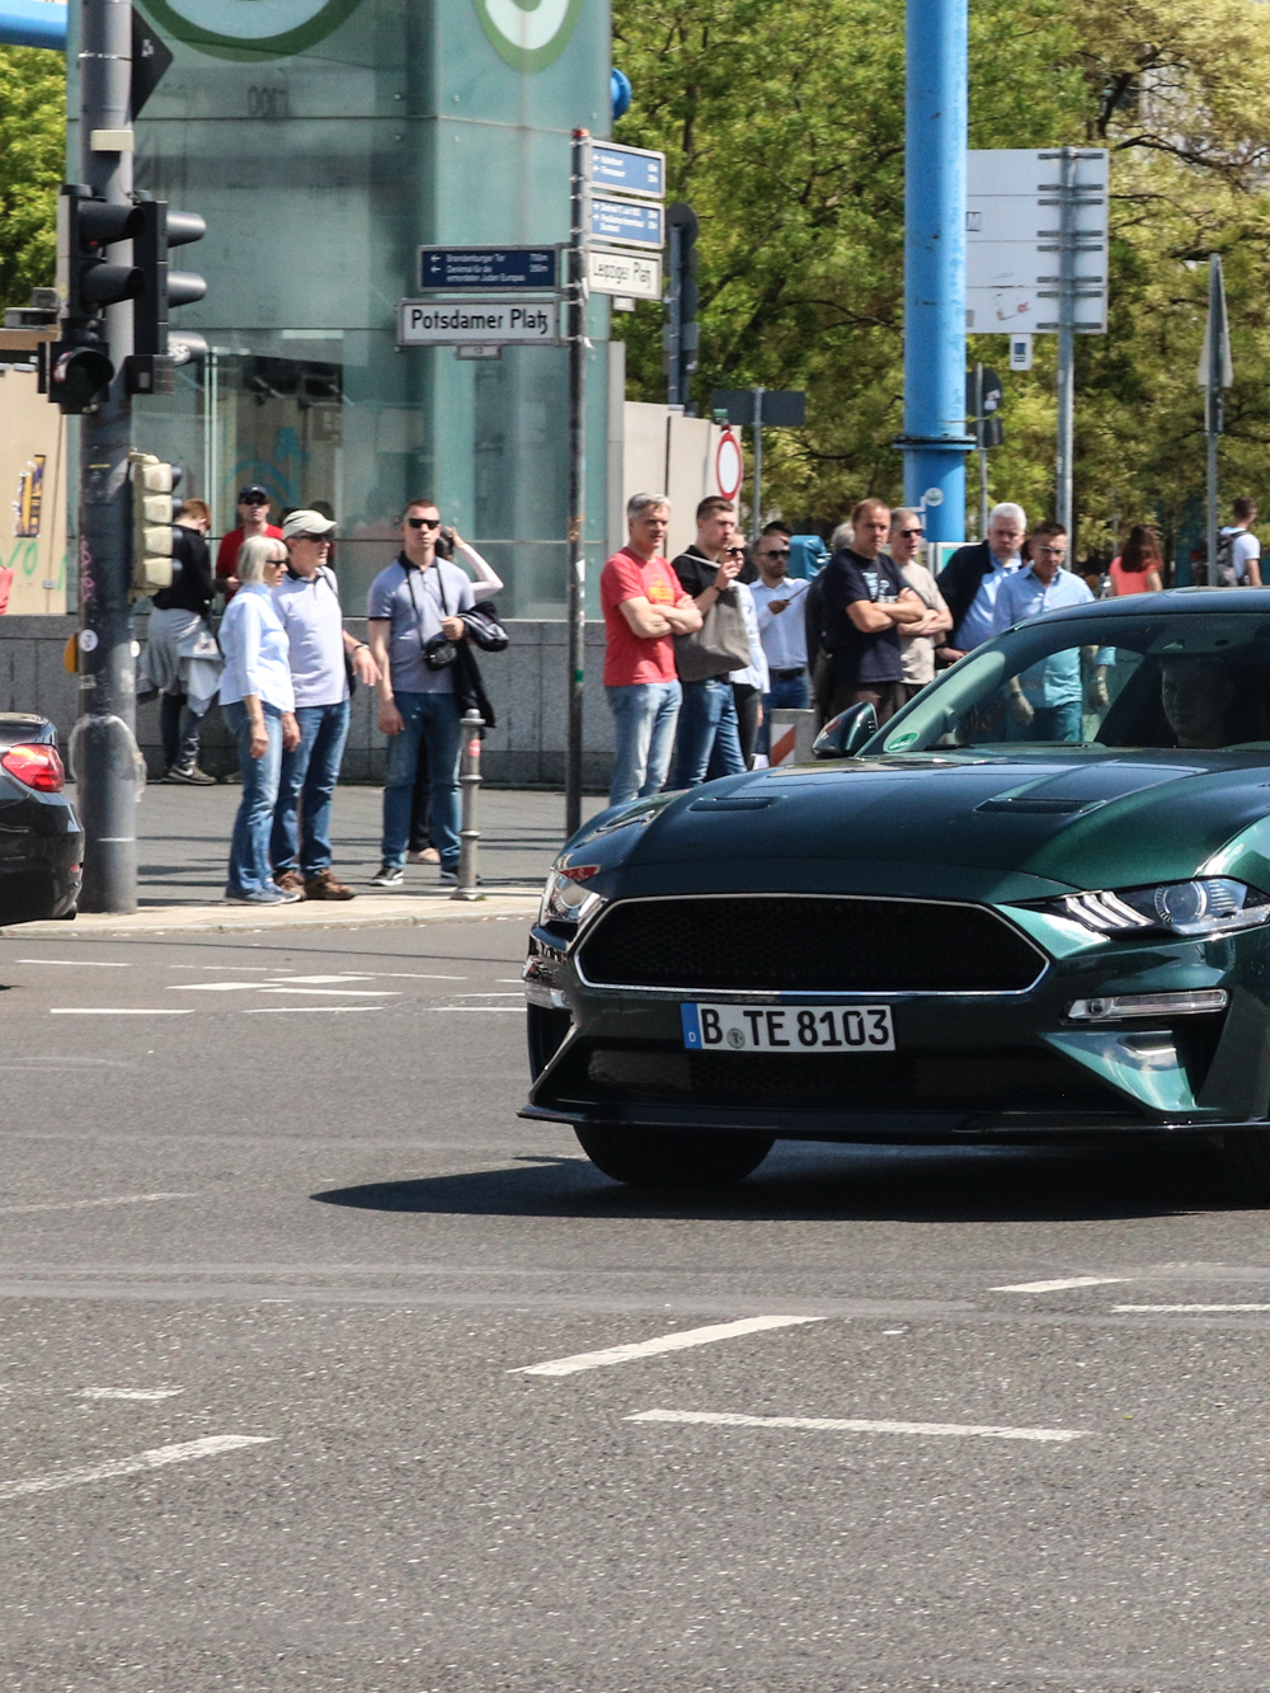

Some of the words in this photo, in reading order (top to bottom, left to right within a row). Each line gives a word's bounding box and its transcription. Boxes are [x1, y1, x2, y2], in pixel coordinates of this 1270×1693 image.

[593, 256, 630, 284] Leipziger
[411, 309, 503, 329] Potsdamer
[510, 309, 548, 334] Platz
[701, 1009, 723, 1044] B
[743, 1010, 790, 1046] TE
[797, 1010, 889, 1046] 8103
